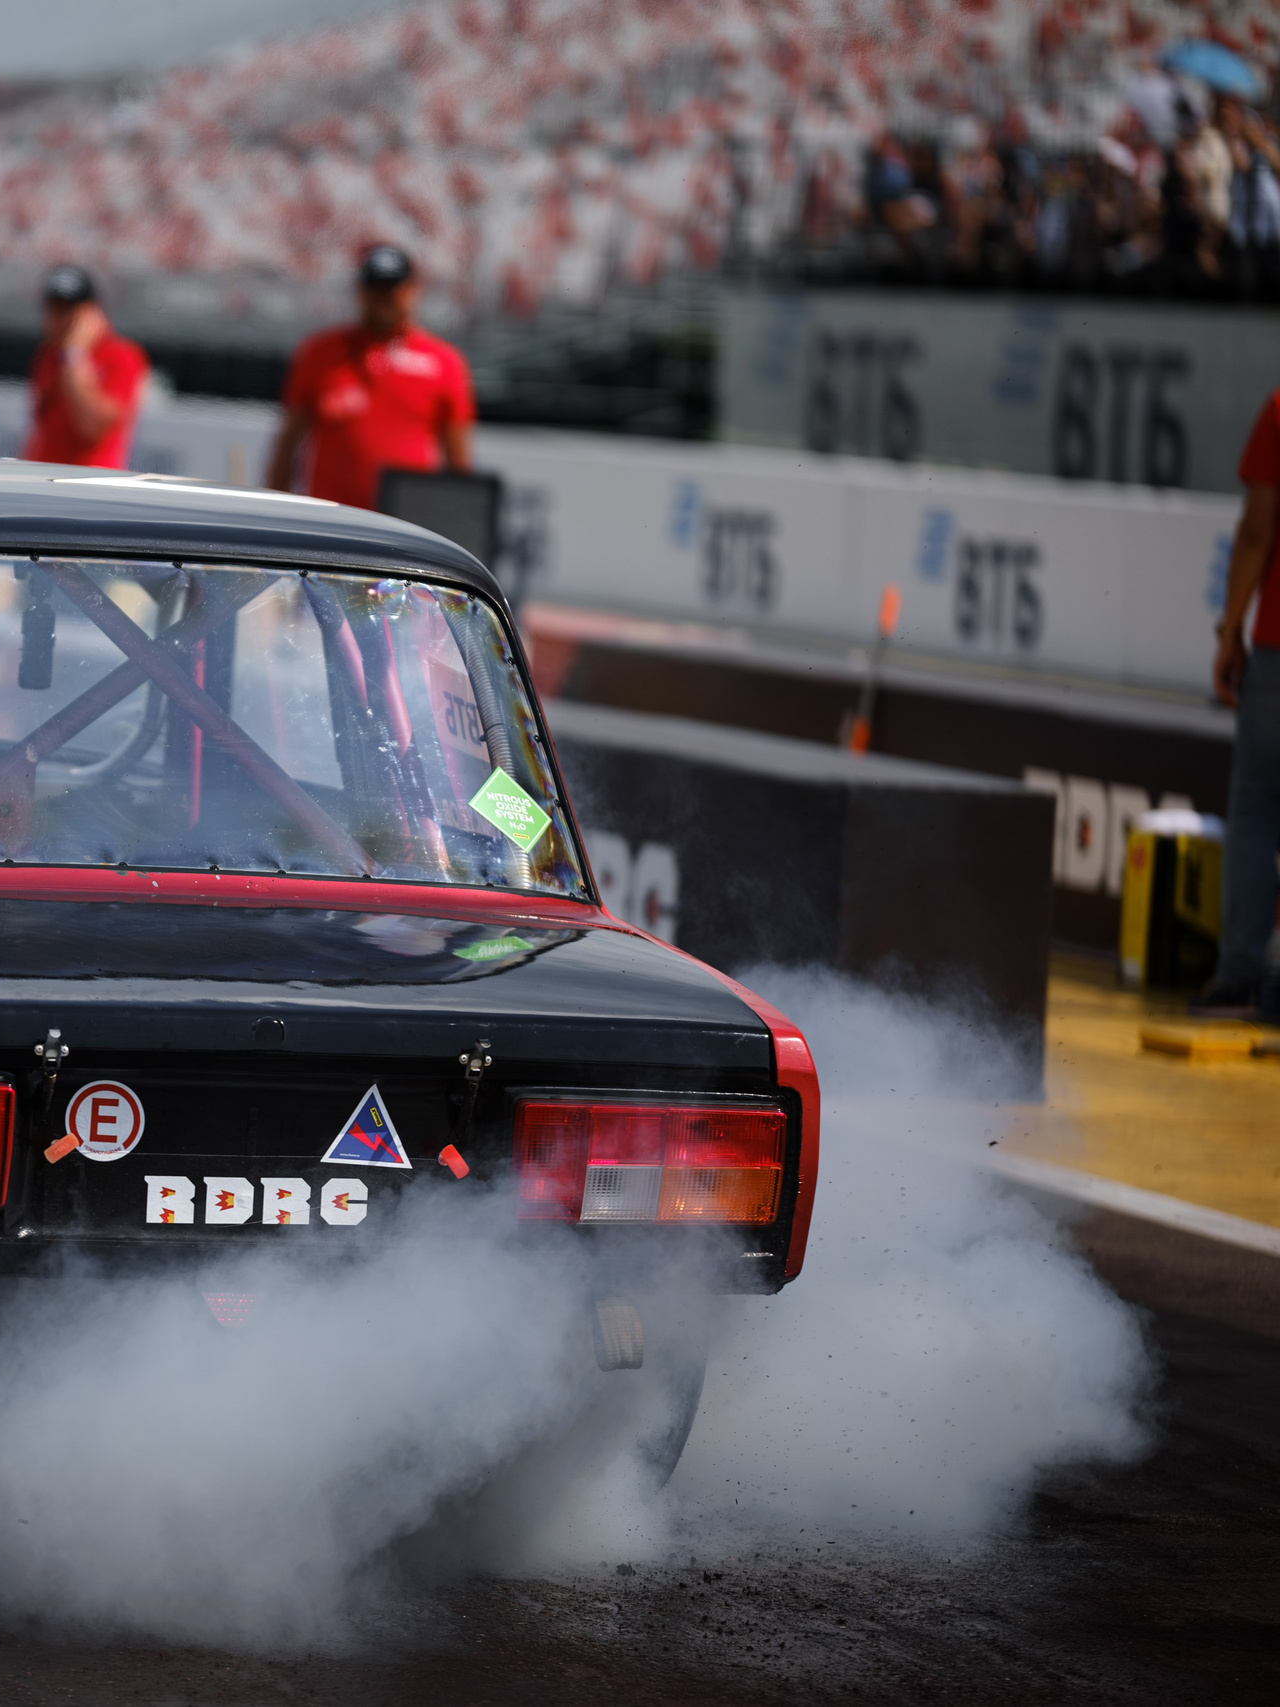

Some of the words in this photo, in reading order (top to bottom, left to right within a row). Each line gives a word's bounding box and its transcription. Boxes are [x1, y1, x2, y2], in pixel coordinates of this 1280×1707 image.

[486, 791, 531, 808] NITROUS
[496, 801, 528, 814] OXIDE
[494, 809, 534, 824] SYSTEM
[89, 1097, 120, 1144] E
[144, 1175, 368, 1226] RDRC
